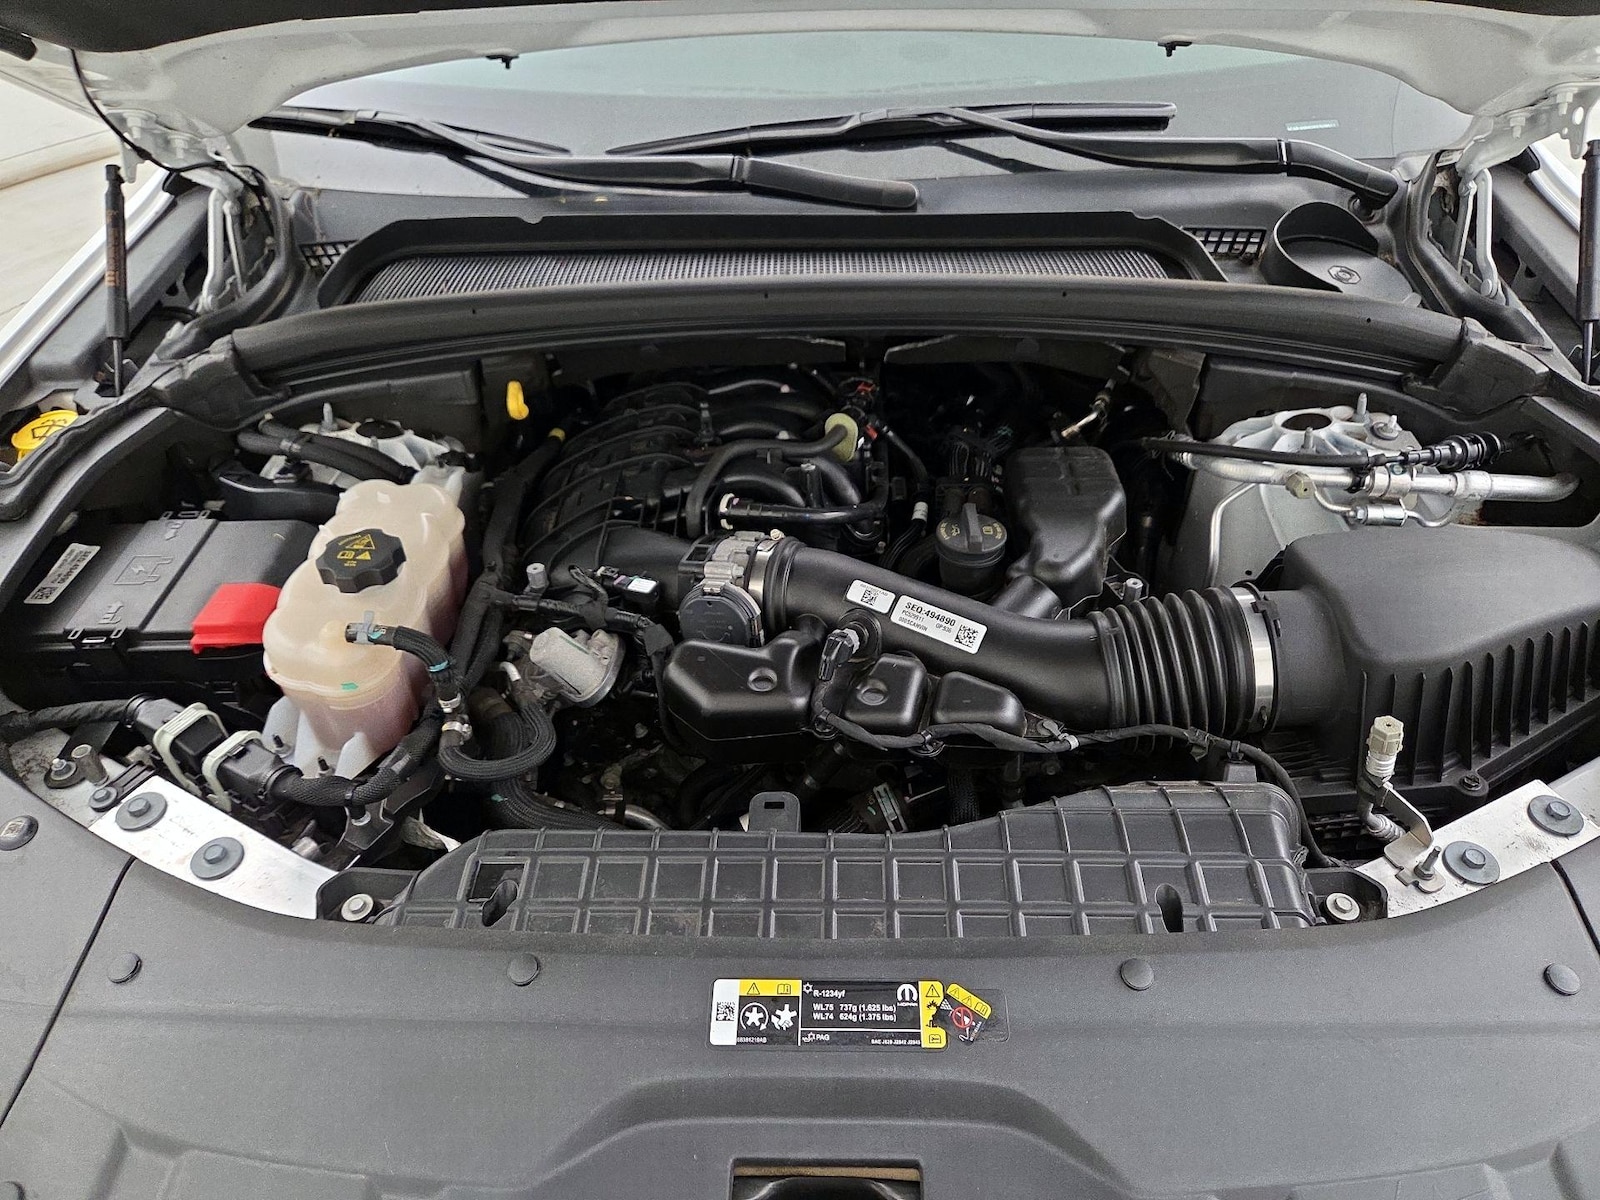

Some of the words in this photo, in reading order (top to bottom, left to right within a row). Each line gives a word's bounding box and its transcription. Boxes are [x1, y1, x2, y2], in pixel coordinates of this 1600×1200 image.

[813, 989, 846, 999] R-1234yf
[813, 1003, 834, 1011] WL75
[839, 1003, 858, 1013] 737g
[859, 1003, 881, 1013] (1.625
[882, 1003, 897, 1013] lbs)
[813, 1012, 834, 1020] WL74
[839, 1012, 858, 1022] 624g
[859, 1012, 881, 1022] (1.375
[882, 1012, 897, 1022] lbs)
[816, 1033, 830, 1041] PAG
